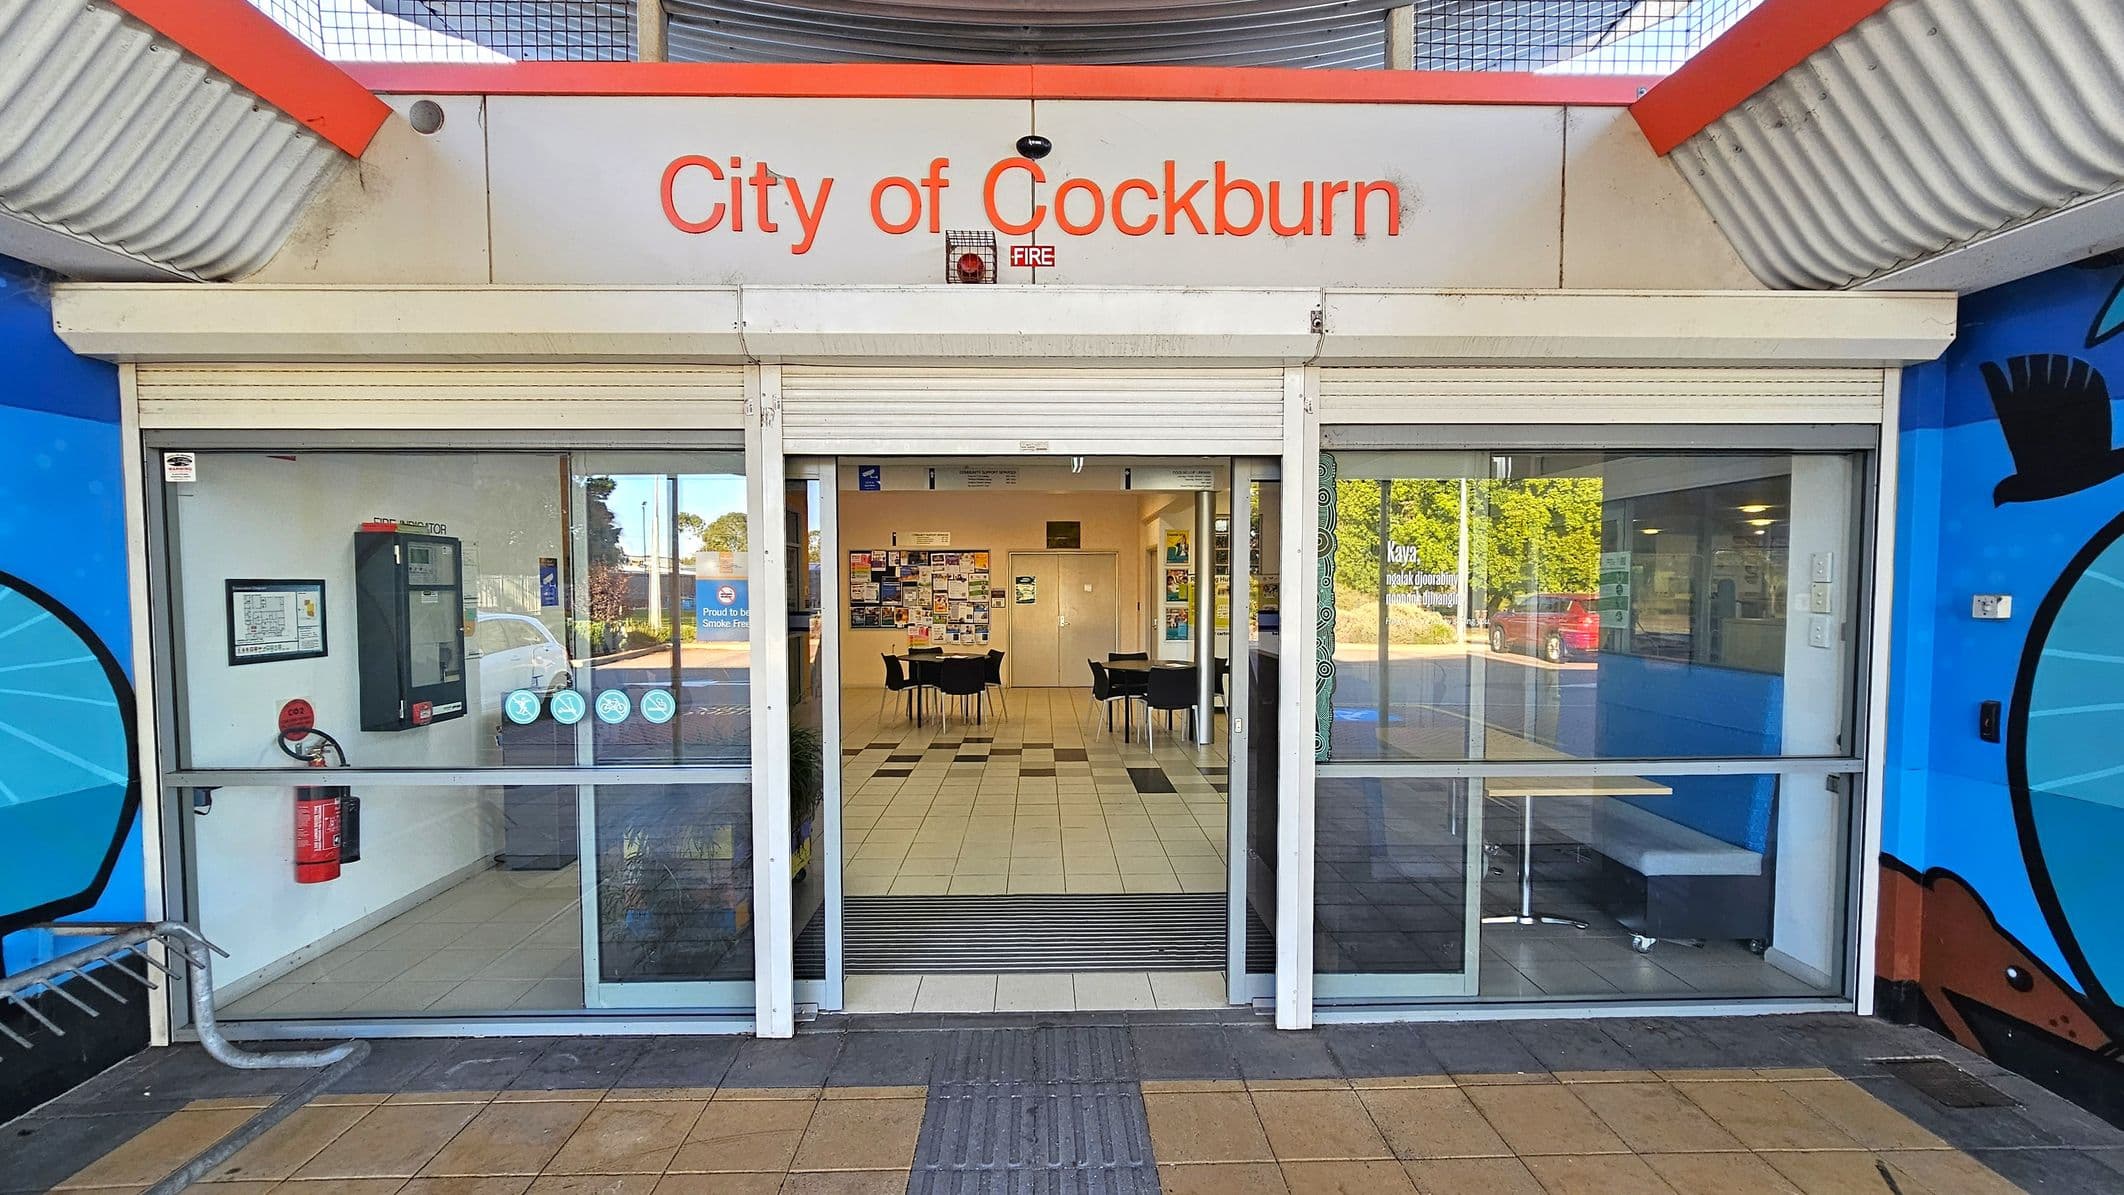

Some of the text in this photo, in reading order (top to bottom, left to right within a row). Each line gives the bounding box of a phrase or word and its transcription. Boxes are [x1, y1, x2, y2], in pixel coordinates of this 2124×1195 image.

[661, 155, 1400, 254] City of Cockburn
[1013, 247, 1053, 265] FIRE
[1387, 541, 1420, 566] Kaya,
[1386, 570, 1414, 588] ngalak
[703, 608, 727, 617] Proud
[729, 608, 738, 617] to
[703, 619, 731, 628] Smoke
